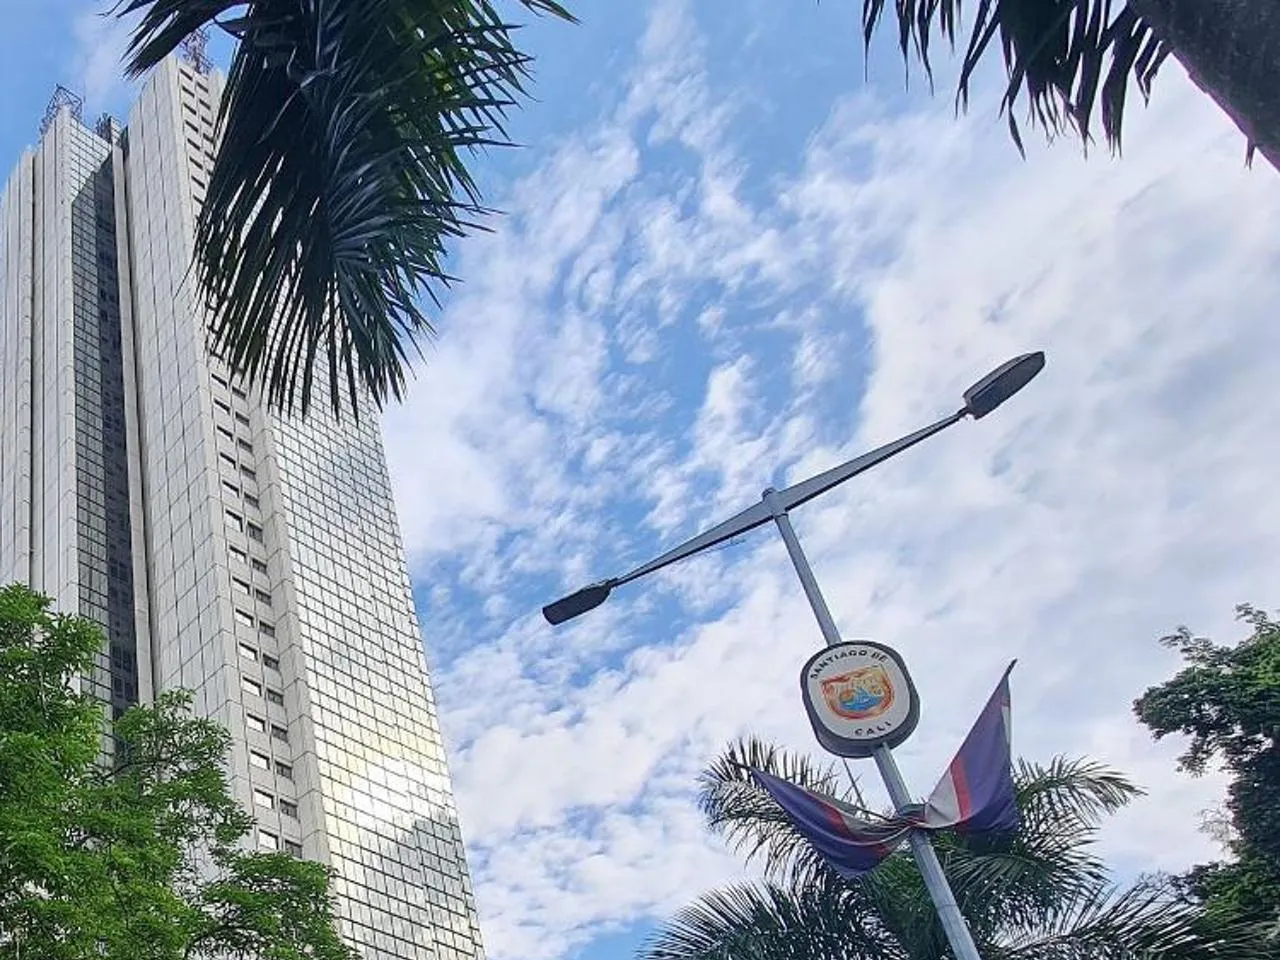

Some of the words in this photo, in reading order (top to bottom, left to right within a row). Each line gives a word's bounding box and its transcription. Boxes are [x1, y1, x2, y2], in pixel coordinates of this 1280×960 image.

[810, 649, 868, 679] SANTIAGO
[870, 652, 888, 663] DE
[854, 720, 892, 736] CALI
